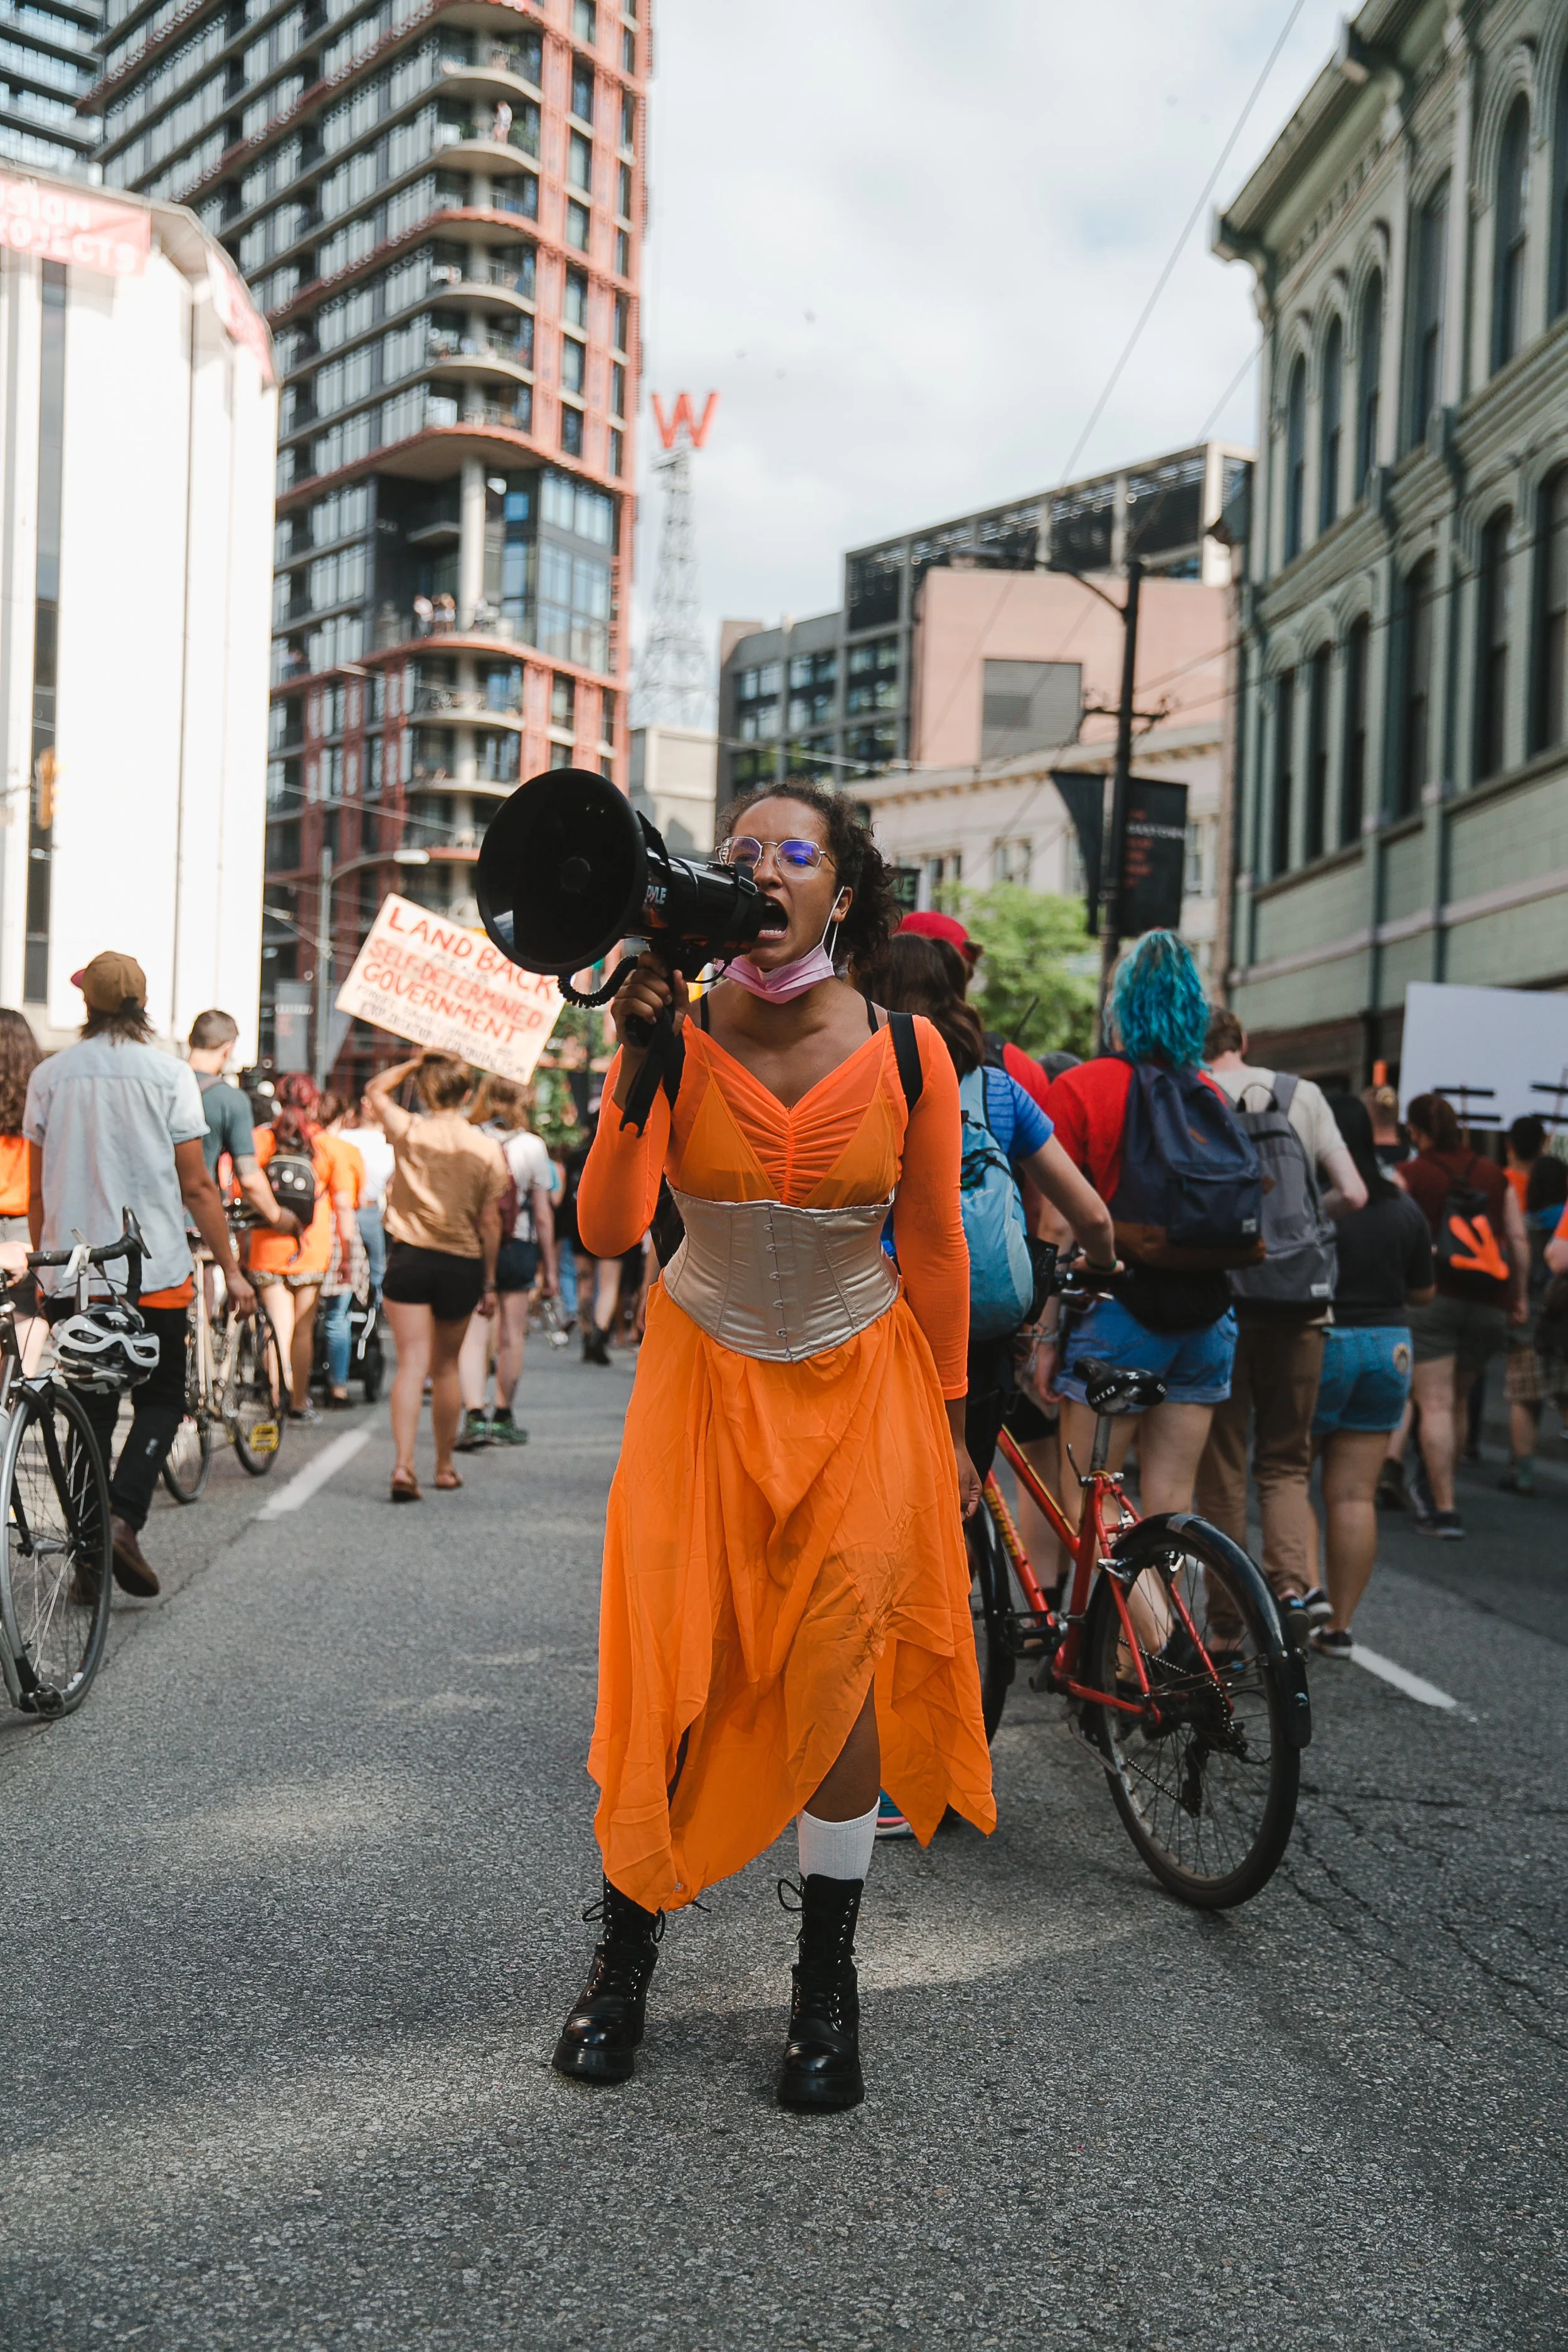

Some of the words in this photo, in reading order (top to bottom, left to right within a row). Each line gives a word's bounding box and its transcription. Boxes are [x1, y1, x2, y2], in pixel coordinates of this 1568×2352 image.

[651, 393, 720, 448] W
[369, 938, 543, 1029] SELF-DETERMINED
[388, 907, 472, 958] LAND
[477, 947, 558, 1000] BACK
[363, 963, 525, 1045] GOVERNMENT
